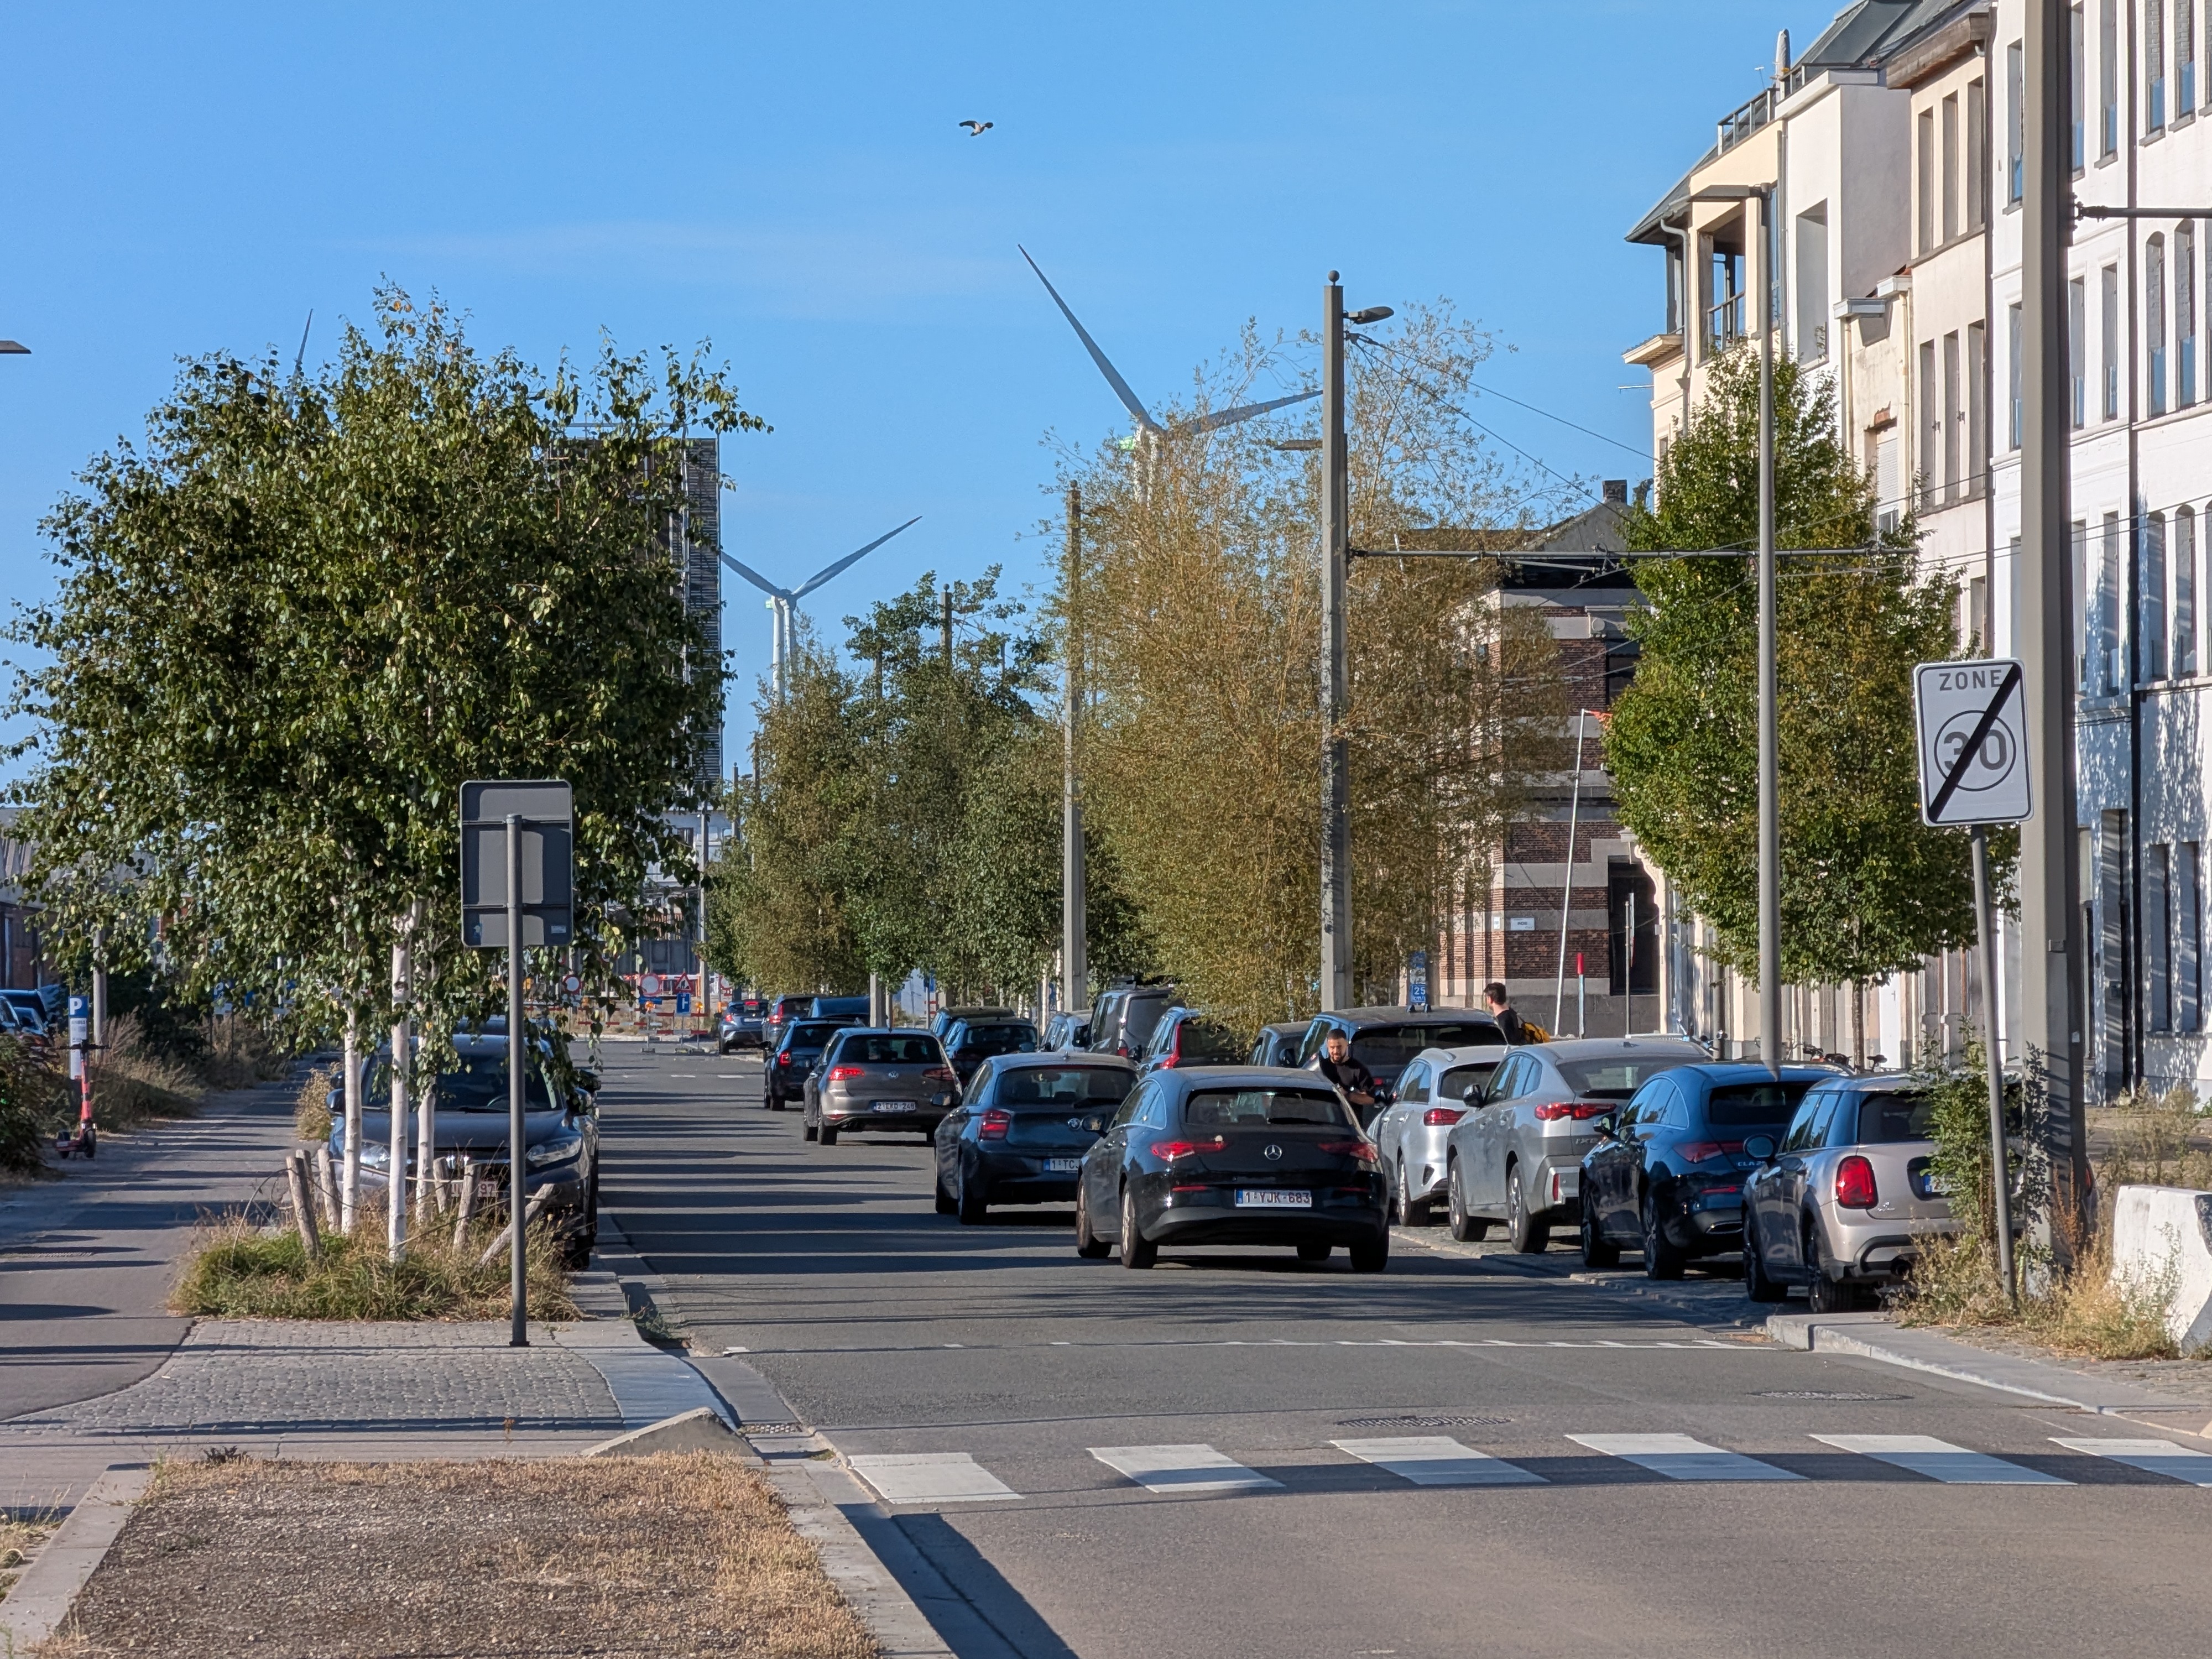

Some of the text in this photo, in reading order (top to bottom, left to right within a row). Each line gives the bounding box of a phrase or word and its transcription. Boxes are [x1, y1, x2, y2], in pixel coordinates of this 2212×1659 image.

[1939, 670, 2002, 691] ZONE
[1943, 729, 2007, 770] 30
[1414, 987, 1426, 995] 25
[69, 998, 82, 1015] P
